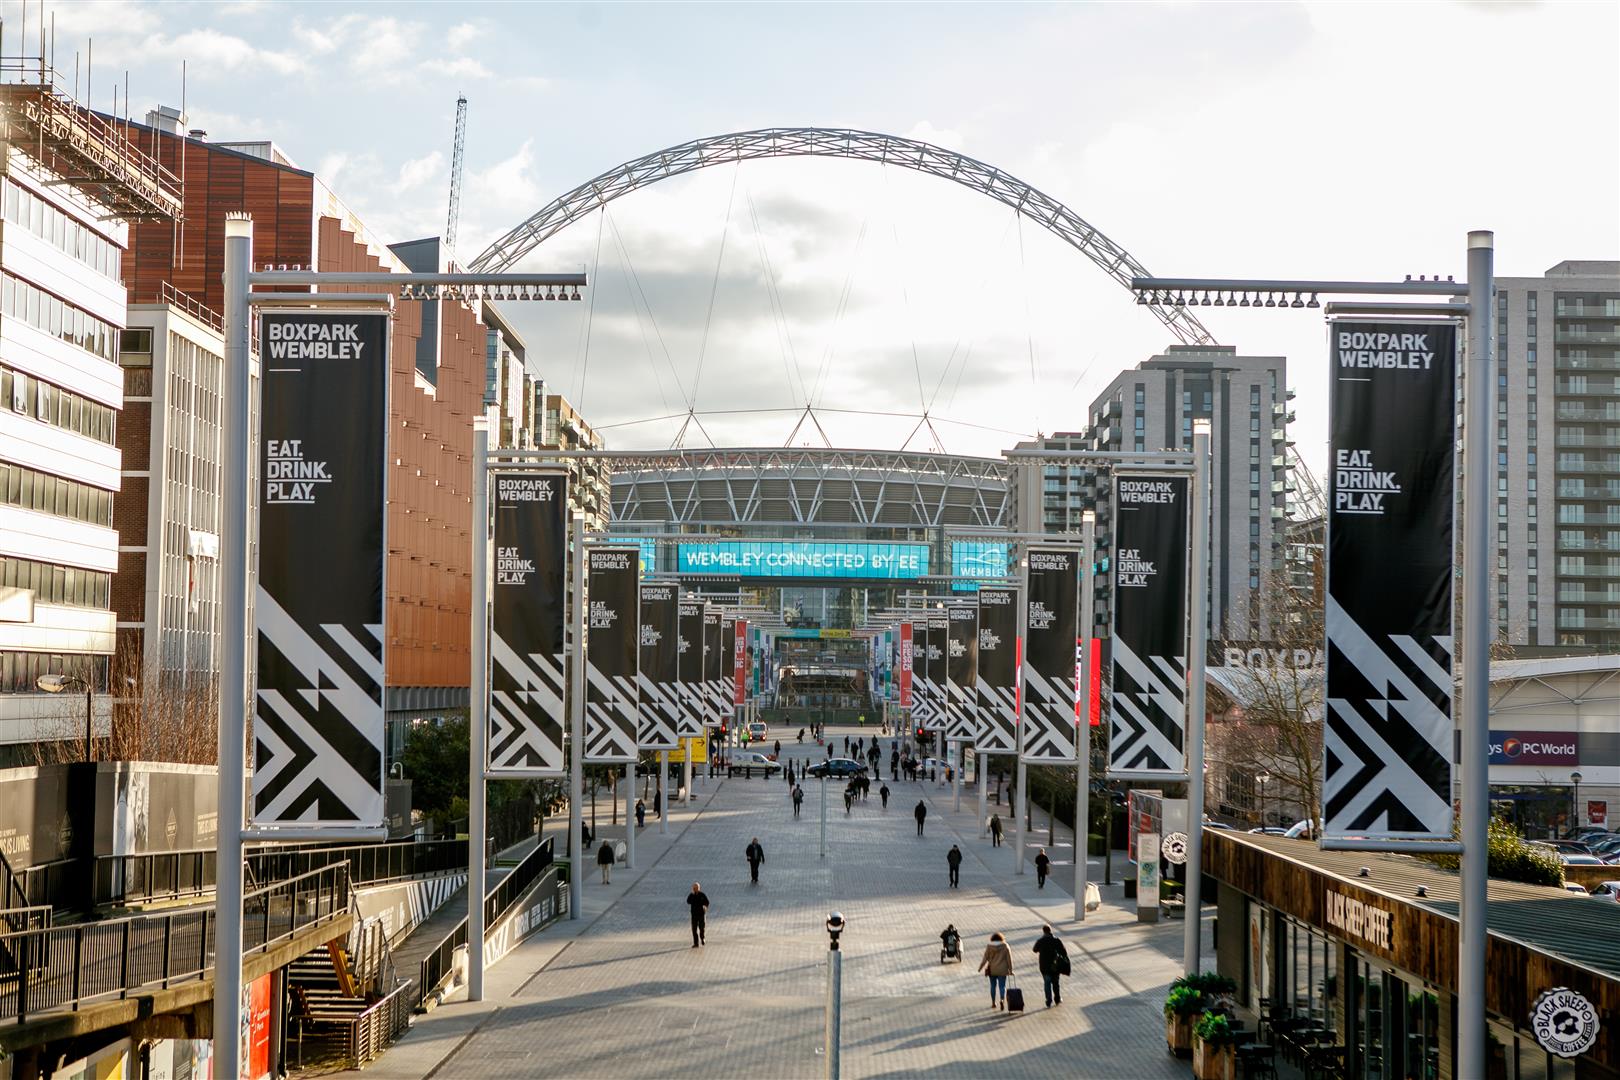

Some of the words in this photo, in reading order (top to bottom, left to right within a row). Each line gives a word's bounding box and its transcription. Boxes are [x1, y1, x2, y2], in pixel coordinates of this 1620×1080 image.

[269, 323, 359, 341] BOXPARK
[1339, 332, 1428, 351] BOXPARK
[269, 342, 365, 359] WEMBLEY
[1339, 351, 1434, 369] WEMBLEY
[267, 440, 303, 457] EAT.
[1336, 449, 1373, 467] EAT.
[267, 461, 332, 479] DRINK.
[499, 480, 550, 491] BOXPARK
[1336, 471, 1401, 489] DRINK.
[266, 482, 315, 500] PLAY.
[1120, 481, 1172, 493] BOXPARK
[499, 490, 554, 501] WEMBLEY
[1120, 492, 1175, 503] WEMBLEY
[1336, 493, 1384, 510] PLAY.
[498, 547, 519, 558] EAT.
[591, 553, 628, 562] BOXPARK
[1030, 554, 1067, 562] BOXPARK
[1120, 549, 1141, 560] EAT.
[497, 560, 535, 570] DRINK.
[591, 561, 631, 570] WEMBLEY
[687, 552, 764, 567] WEMBLEY
[766, 553, 865, 568] CONNECTED
[872, 555, 892, 568] BY
[900, 555, 919, 569] EE
[1030, 562, 1069, 570] WEMBLEY
[1119, 562, 1157, 572] DRINK.
[497, 572, 526, 583] PLAY.
[1119, 574, 1148, 585] PLAY.
[591, 601, 606, 610] EAT.
[1029, 602, 1045, 610] EAT.
[590, 610, 617, 619] DRINK.
[1029, 610, 1056, 619] DRINK.
[590, 619, 612, 627] PLAY.
[1029, 619, 1050, 628] PLAY.
[1523, 743, 1540, 754] PC
[1541, 743, 1575, 755] World
[1326, 889, 1347, 931] BLACK
[1346, 896, 1364, 938] SHEEP
[1364, 903, 1390, 950] COFFEE
[1537, 998, 1560, 1028] BLACK
[1558, 995, 1588, 1012] SHEEP
[1562, 1036, 1588, 1052] COFFEE
